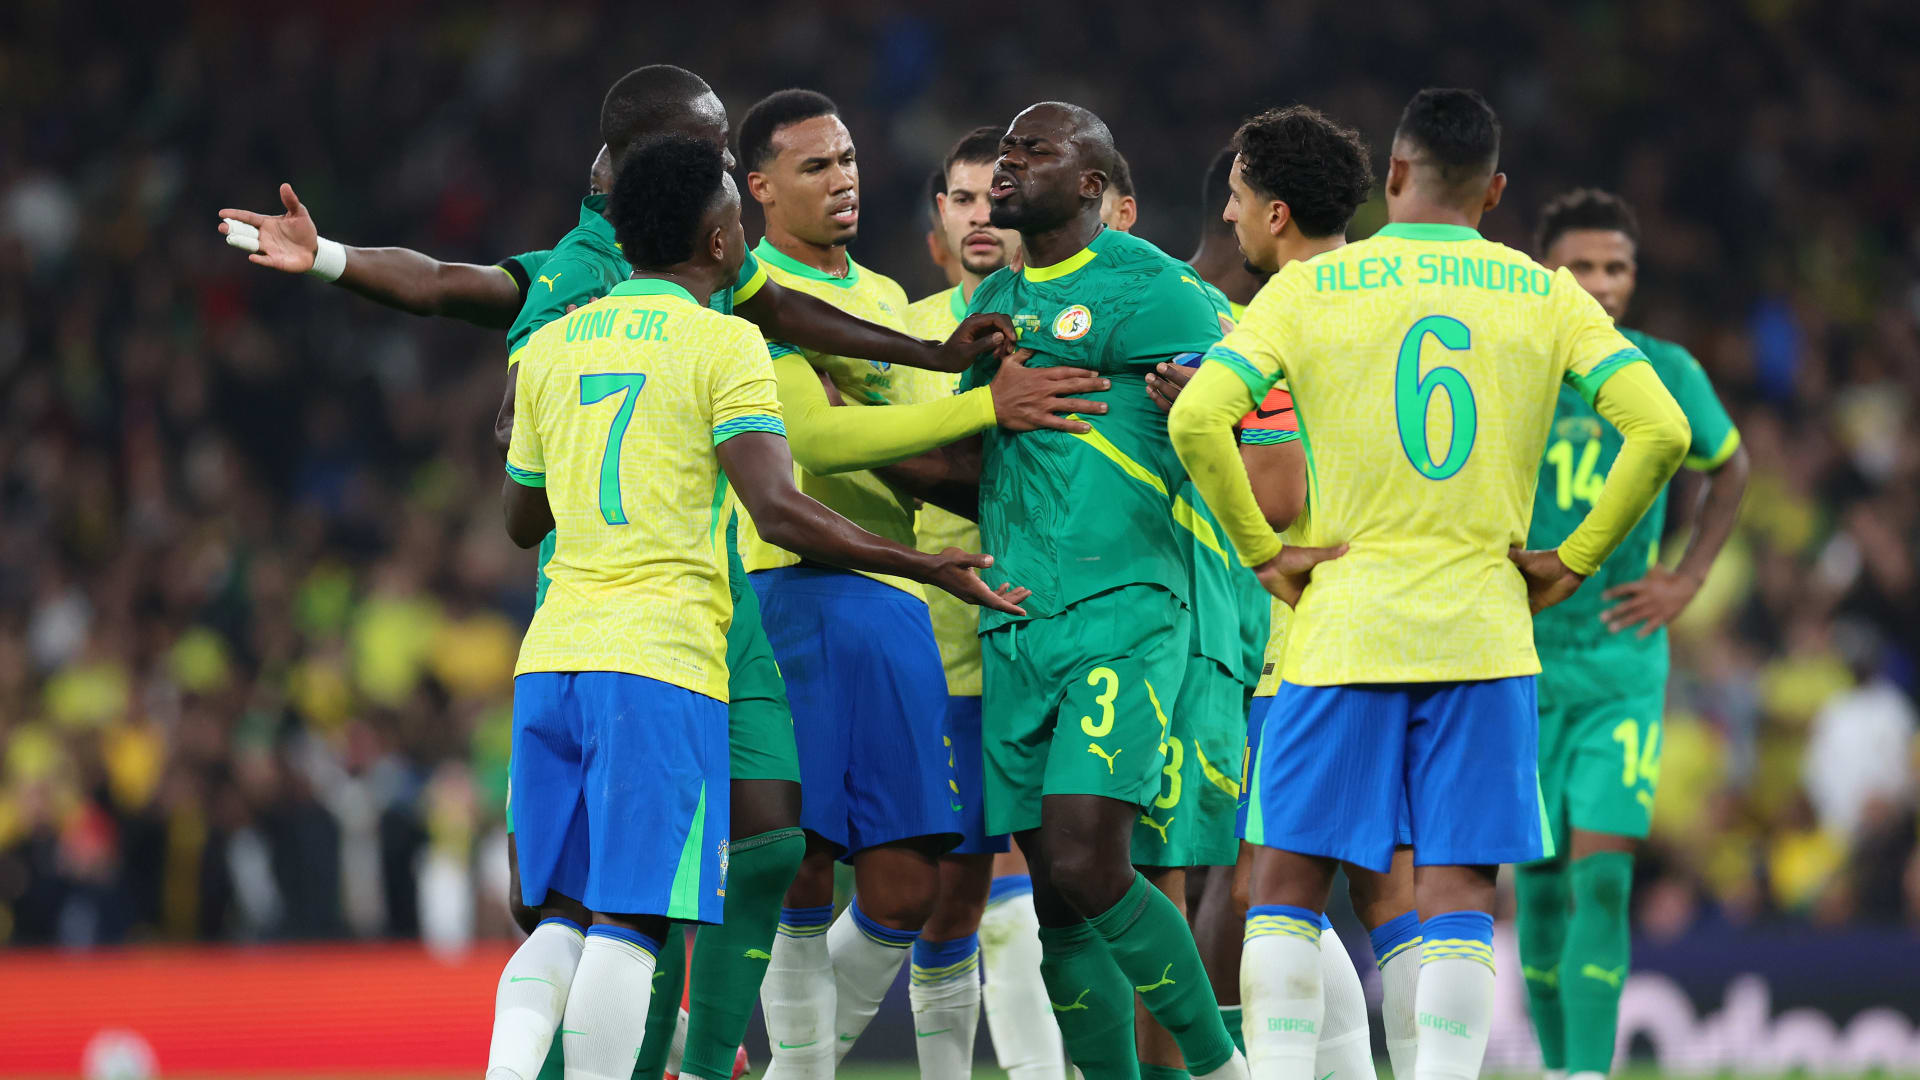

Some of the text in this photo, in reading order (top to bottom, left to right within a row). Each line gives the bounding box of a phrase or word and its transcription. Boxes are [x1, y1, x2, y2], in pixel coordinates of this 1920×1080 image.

[1316, 254, 1550, 296] ALEX SANDRO
[566, 308, 668, 343] VINI JR.
[1395, 315, 1477, 480] 6
[580, 373, 646, 525] 7
[1547, 439, 1604, 510] 14
[1081, 667, 1119, 737] 3
[1612, 717, 1660, 788] 14
[1267, 1016, 1317, 1035] BRASIL
[1419, 1011, 1472, 1038] BRASIL
